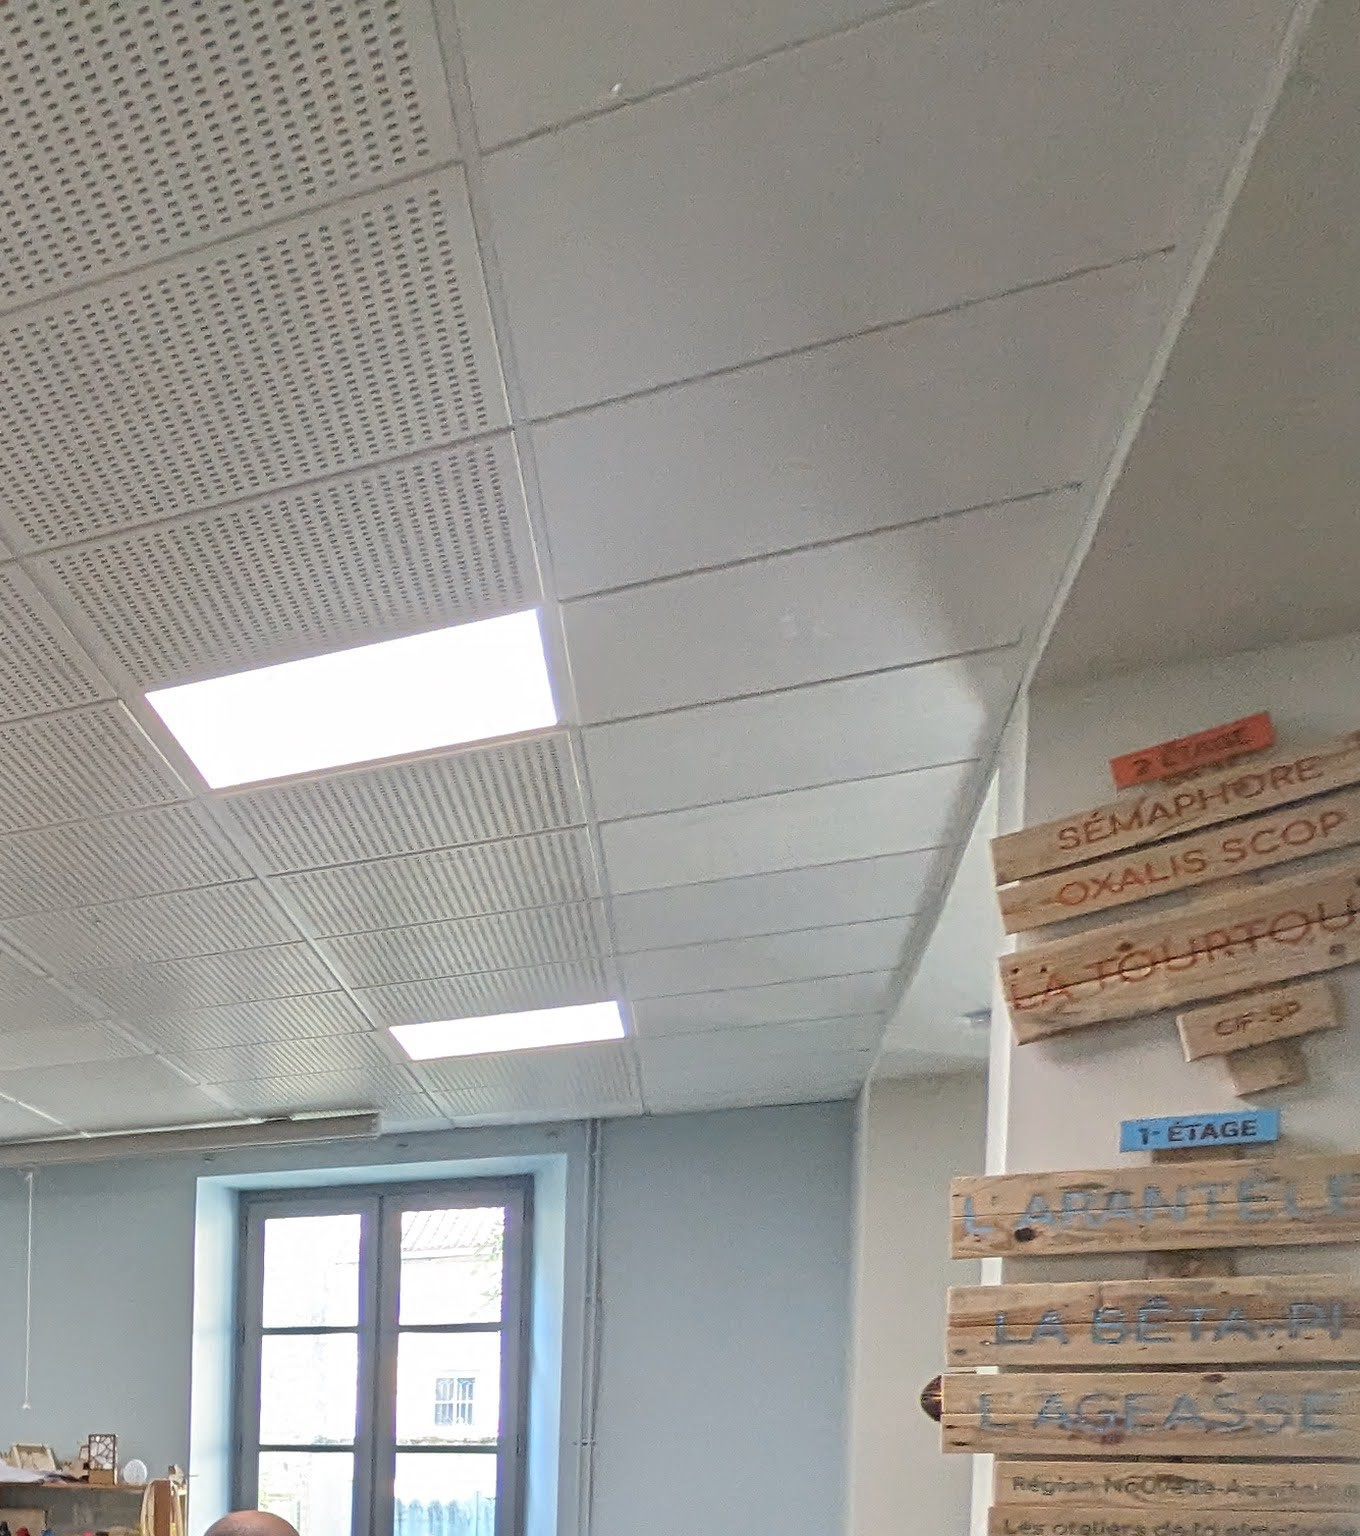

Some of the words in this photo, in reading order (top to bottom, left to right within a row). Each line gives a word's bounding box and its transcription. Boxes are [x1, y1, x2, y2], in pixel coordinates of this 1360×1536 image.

[1058, 754, 1324, 851] SÉMAPHORE
[1055, 852, 1208, 907] OXALIS
[1222, 810, 1348, 863] SCOP
[1009, 976, 1071, 1011] LA
[1168, 1118, 1258, 1142] ÉTAGE
[993, 1308, 1072, 1346] LA
[1003, 1518, 1045, 1536] Les
